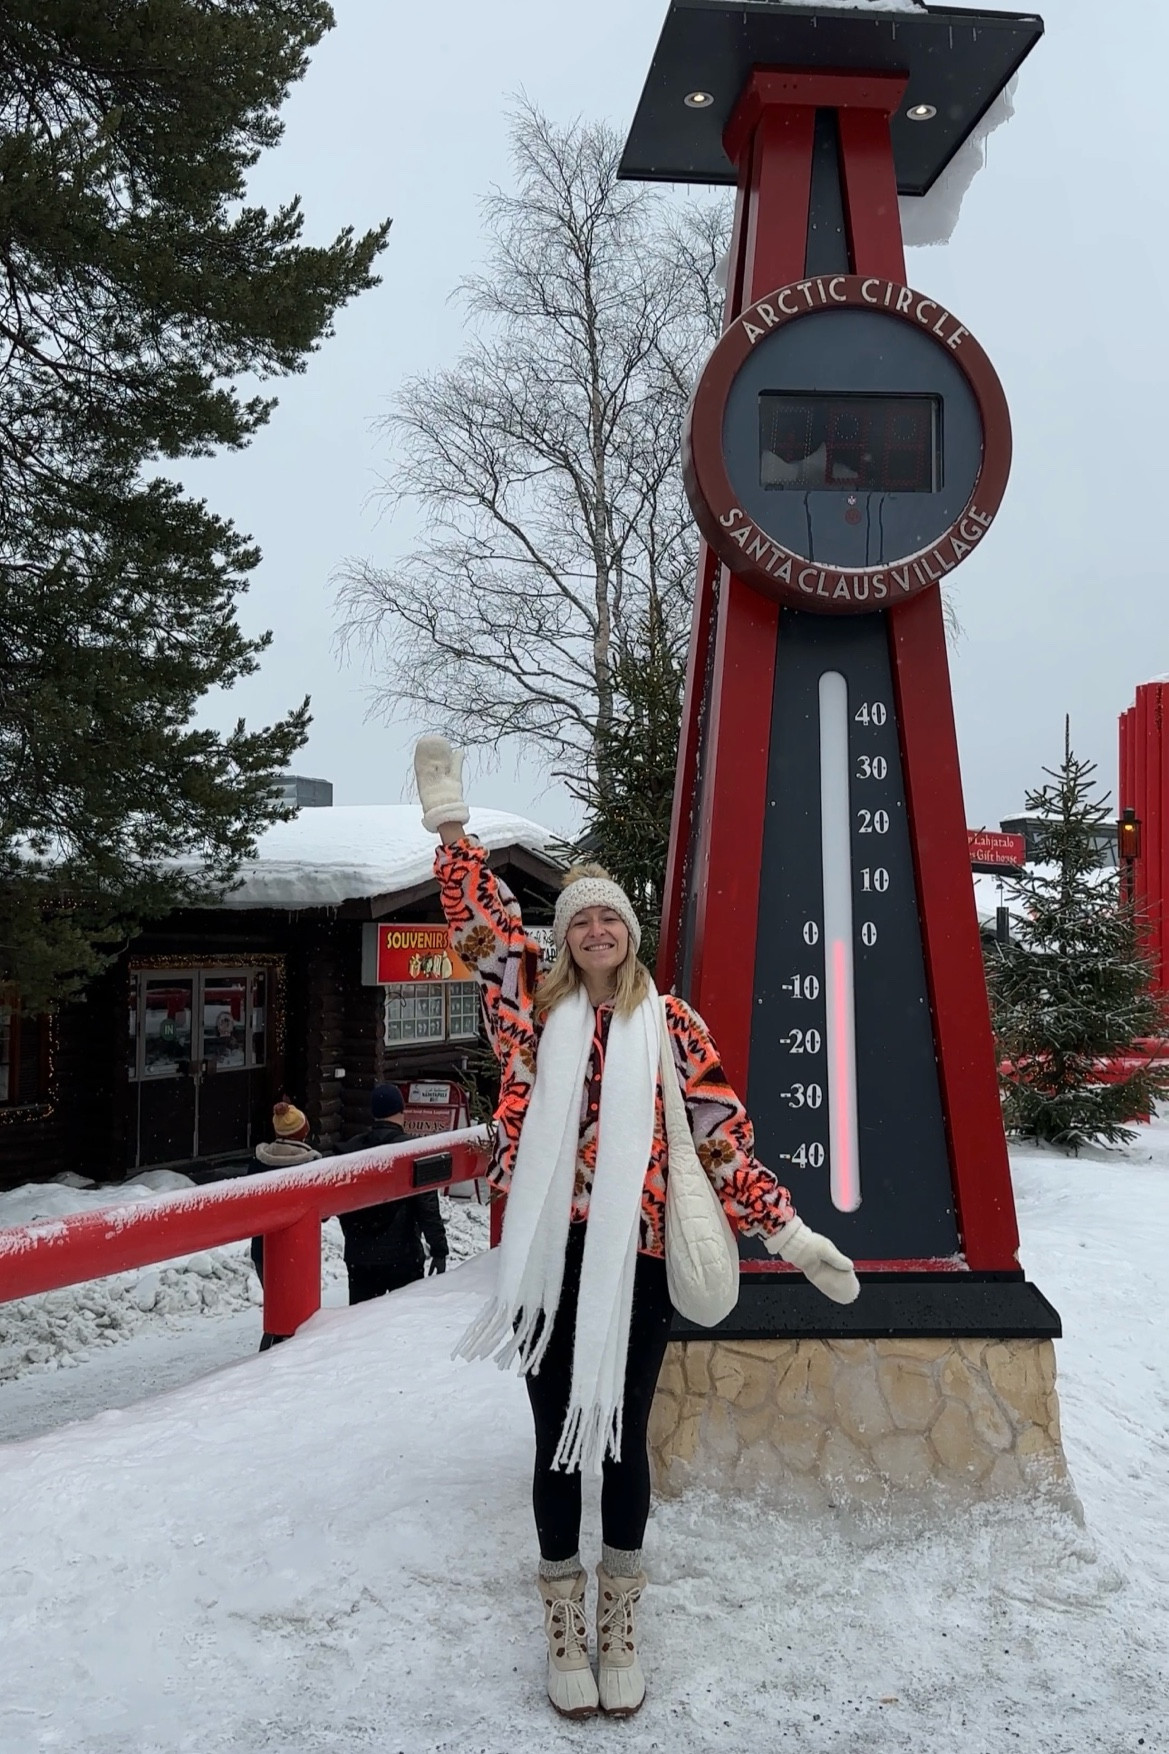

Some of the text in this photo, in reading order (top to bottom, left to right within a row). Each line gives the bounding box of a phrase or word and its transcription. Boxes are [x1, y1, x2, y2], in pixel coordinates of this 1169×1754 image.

[740, 277, 969, 350] ARCTIC CIRCLE
[719, 505, 993, 600] SANTA CLAUS VILLAGE
[854, 701, 887, 726] 40
[856, 755, 888, 780] 30
[857, 809, 890, 834] 20
[976, 849, 995, 862] Gift
[859, 867, 890, 892] 10
[387, 931, 449, 950] SOUVENIRS
[802, 920, 819, 945] 0
[861, 921, 877, 946] 0
[781, 974, 820, 1000] -10
[164, 1024, 174, 1035] IN
[779, 1028, 821, 1054] -20
[780, 1083, 823, 1109] -30
[779, 1142, 825, 1168] -40
